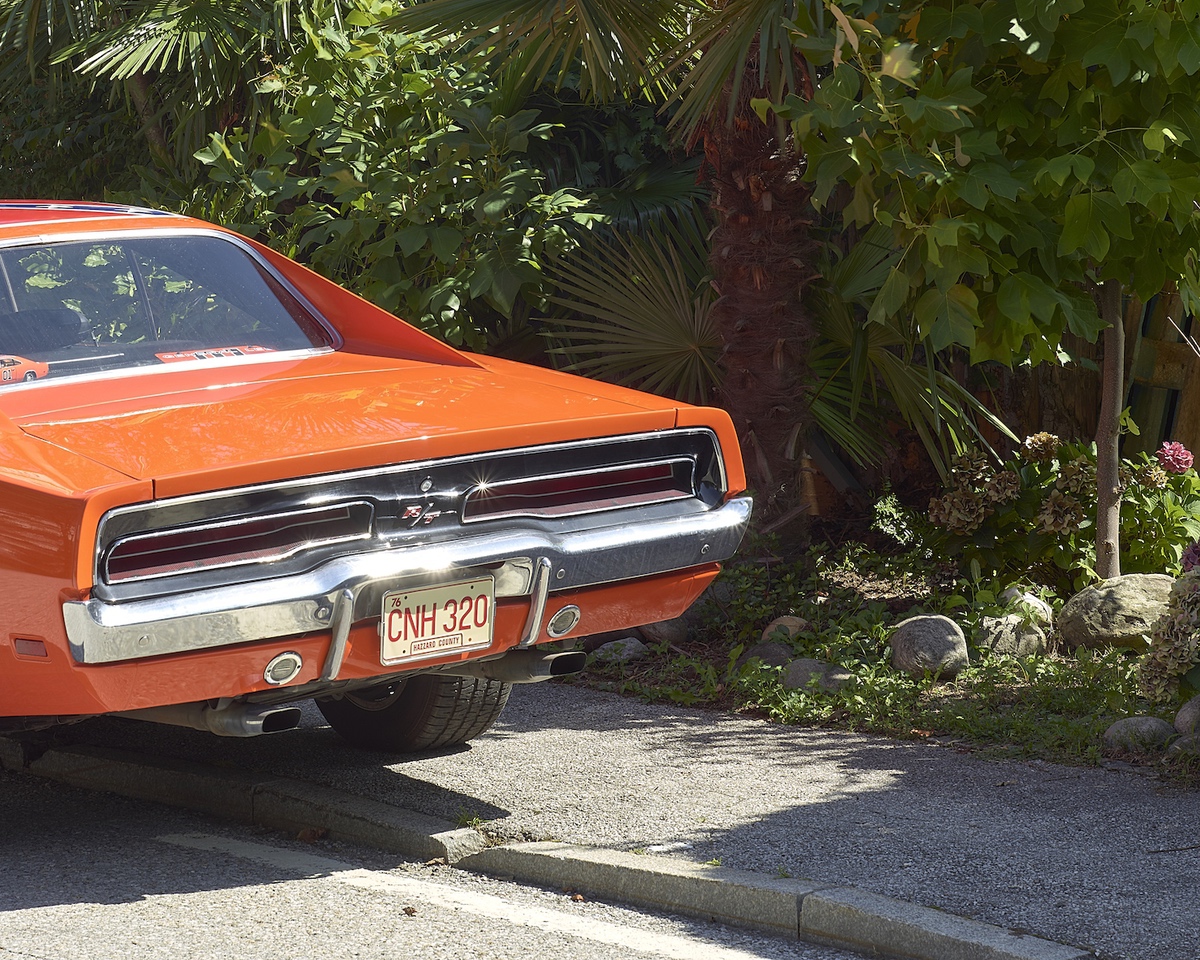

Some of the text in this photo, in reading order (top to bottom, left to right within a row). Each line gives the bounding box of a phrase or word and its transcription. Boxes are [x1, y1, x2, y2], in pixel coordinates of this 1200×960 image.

[391, 598, 401, 608] 76
[387, 594, 489, 643] CNH 320
[413, 637, 460, 652] HAZZARD COUNTY
